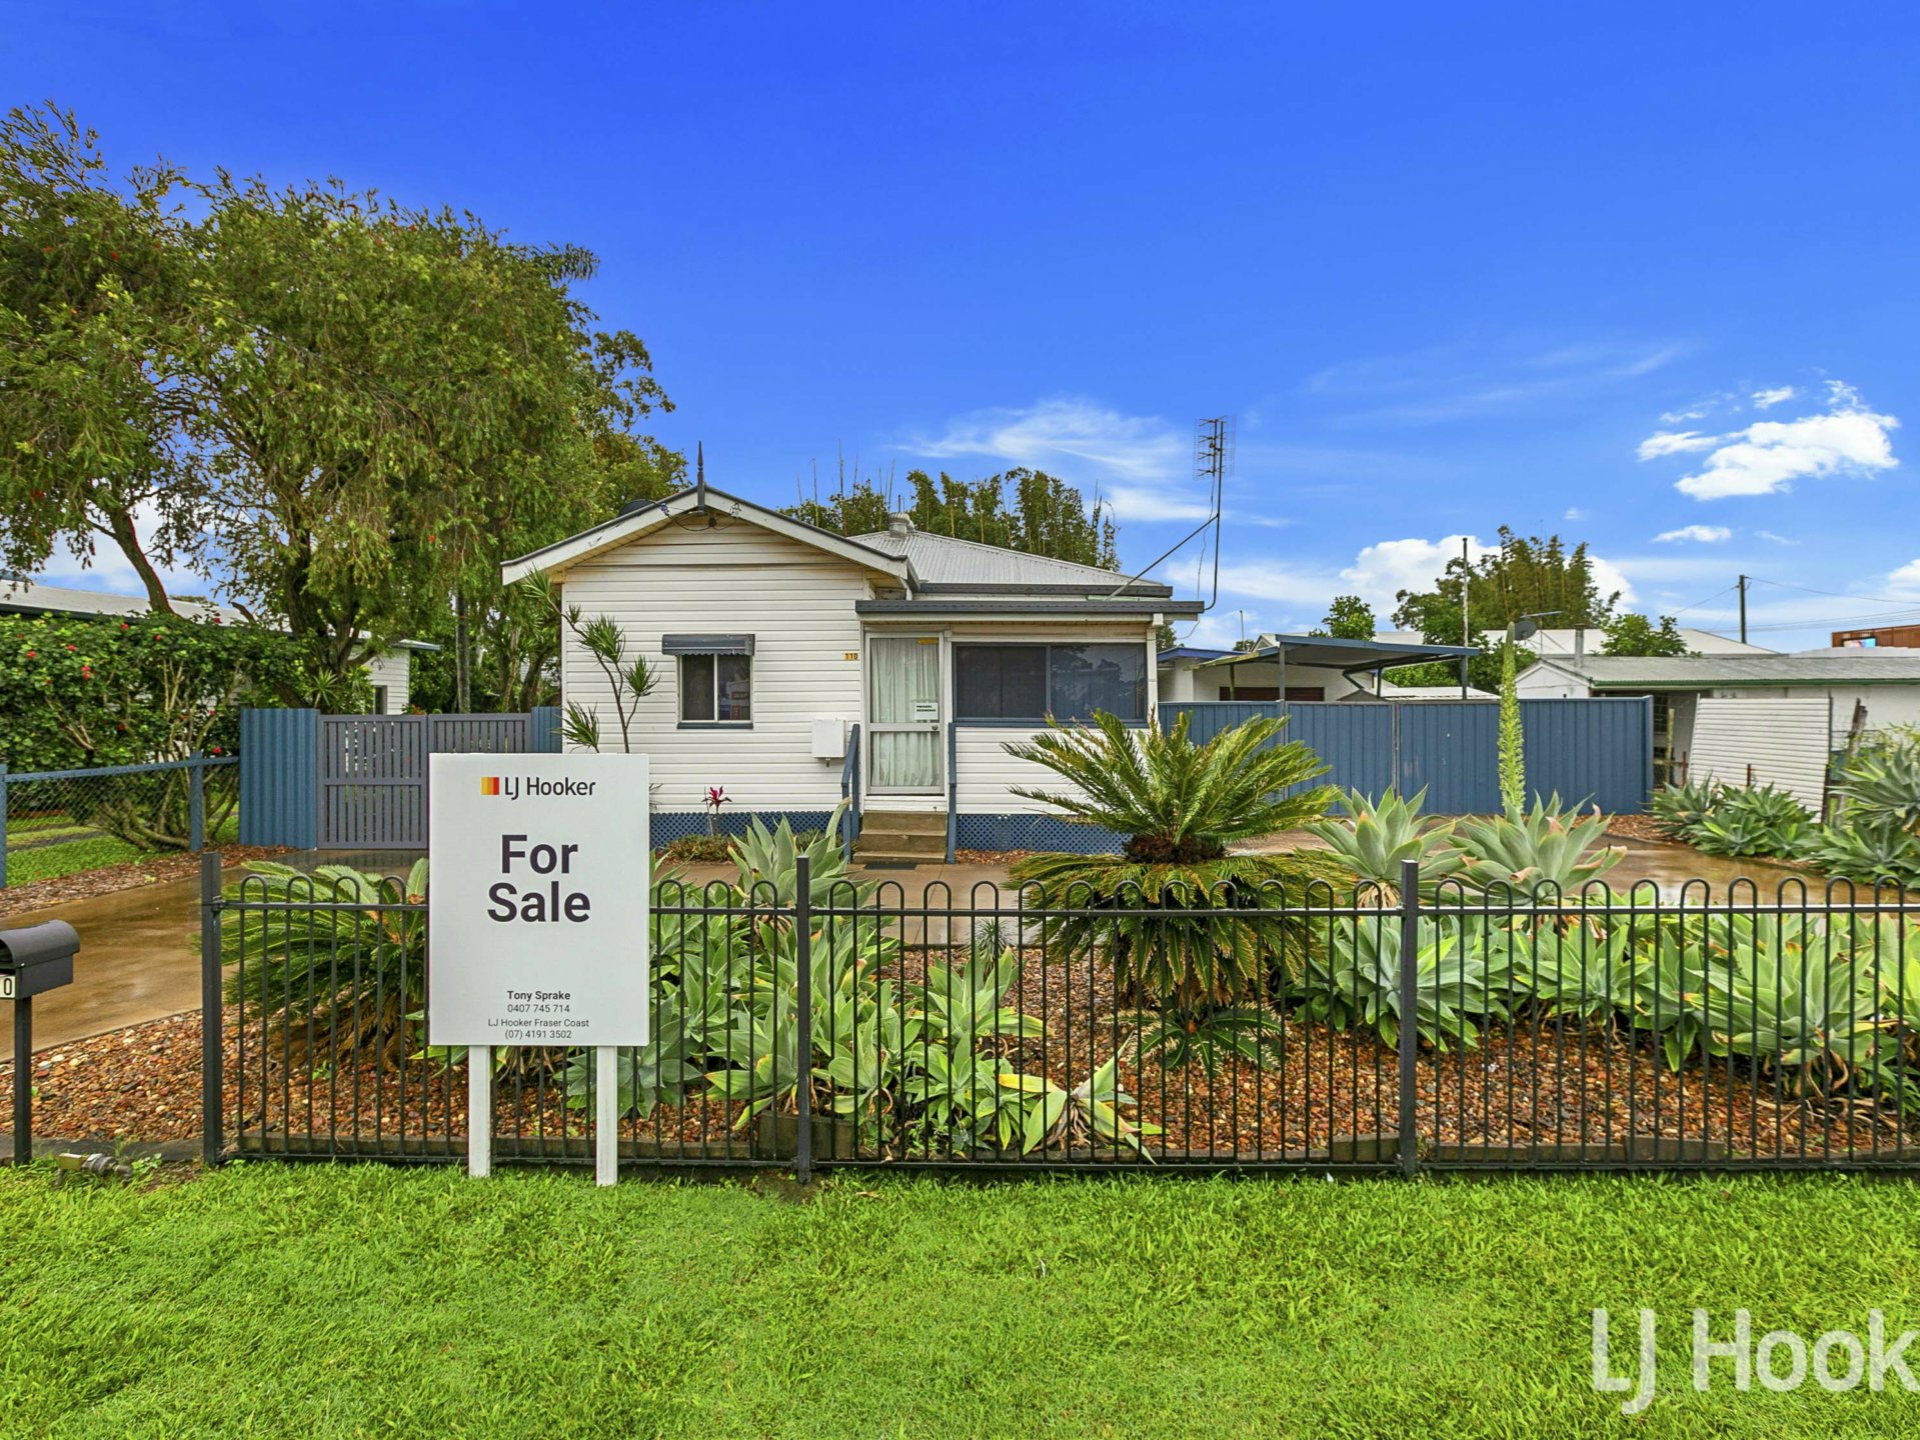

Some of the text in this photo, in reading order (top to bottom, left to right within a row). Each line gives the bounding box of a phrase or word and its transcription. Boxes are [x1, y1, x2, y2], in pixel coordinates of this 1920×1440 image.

[504, 776, 597, 801] LJ Hooker
[501, 834, 579, 875] For
[487, 880, 591, 923] Sale
[507, 990, 571, 1003] Tony Sprake
[507, 1003, 571, 1013] 0407 745 714
[488, 1018, 590, 1028] LJ Hooker Fraser Coast
[504, 1029, 572, 1041] (07) 4191 3502
